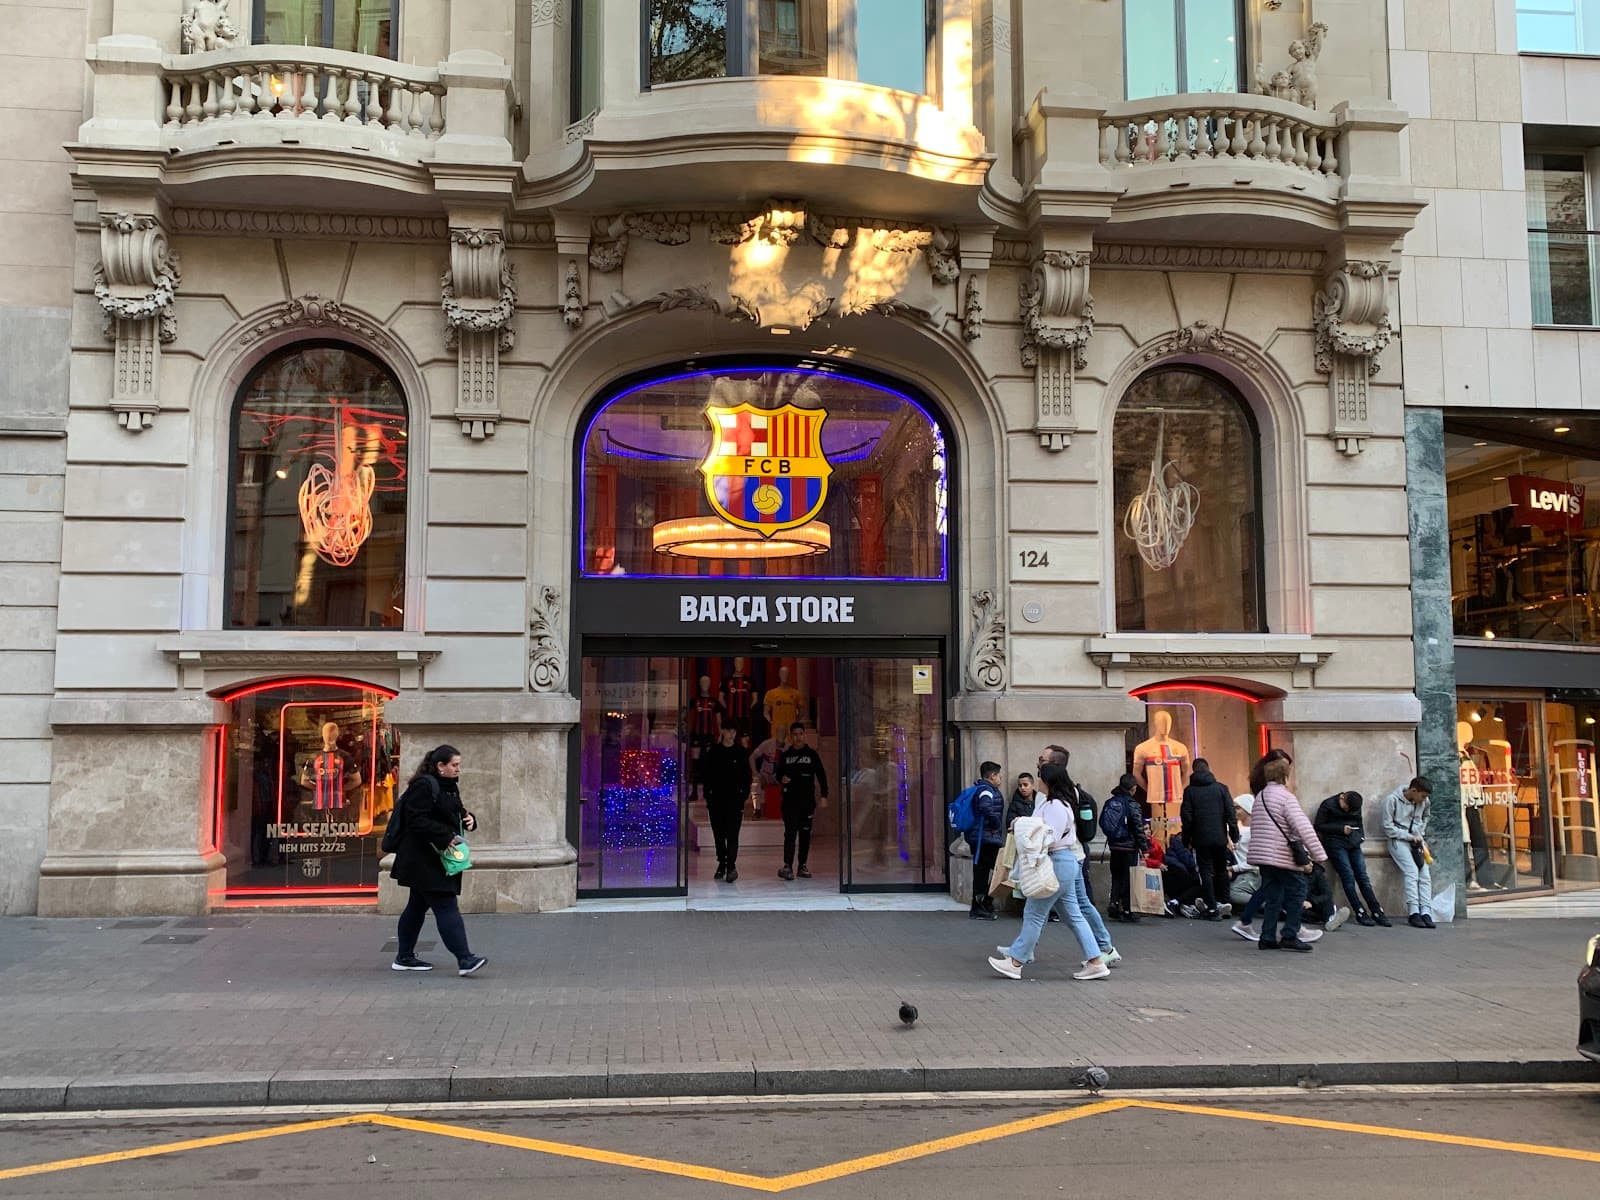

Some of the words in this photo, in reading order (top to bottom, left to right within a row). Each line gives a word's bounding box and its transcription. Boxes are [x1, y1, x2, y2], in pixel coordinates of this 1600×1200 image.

[745, 459, 791, 473] FCB
[1019, 550, 1050, 568] 124
[679, 595, 769, 627] BARÇA
[775, 596, 855, 623] STORE
[266, 823, 299, 838] NEW
[302, 822, 359, 838] SEASON
[279, 843, 297, 853] NEW
[300, 843, 318, 852] KITS
[320, 842, 346, 852] 22/23
